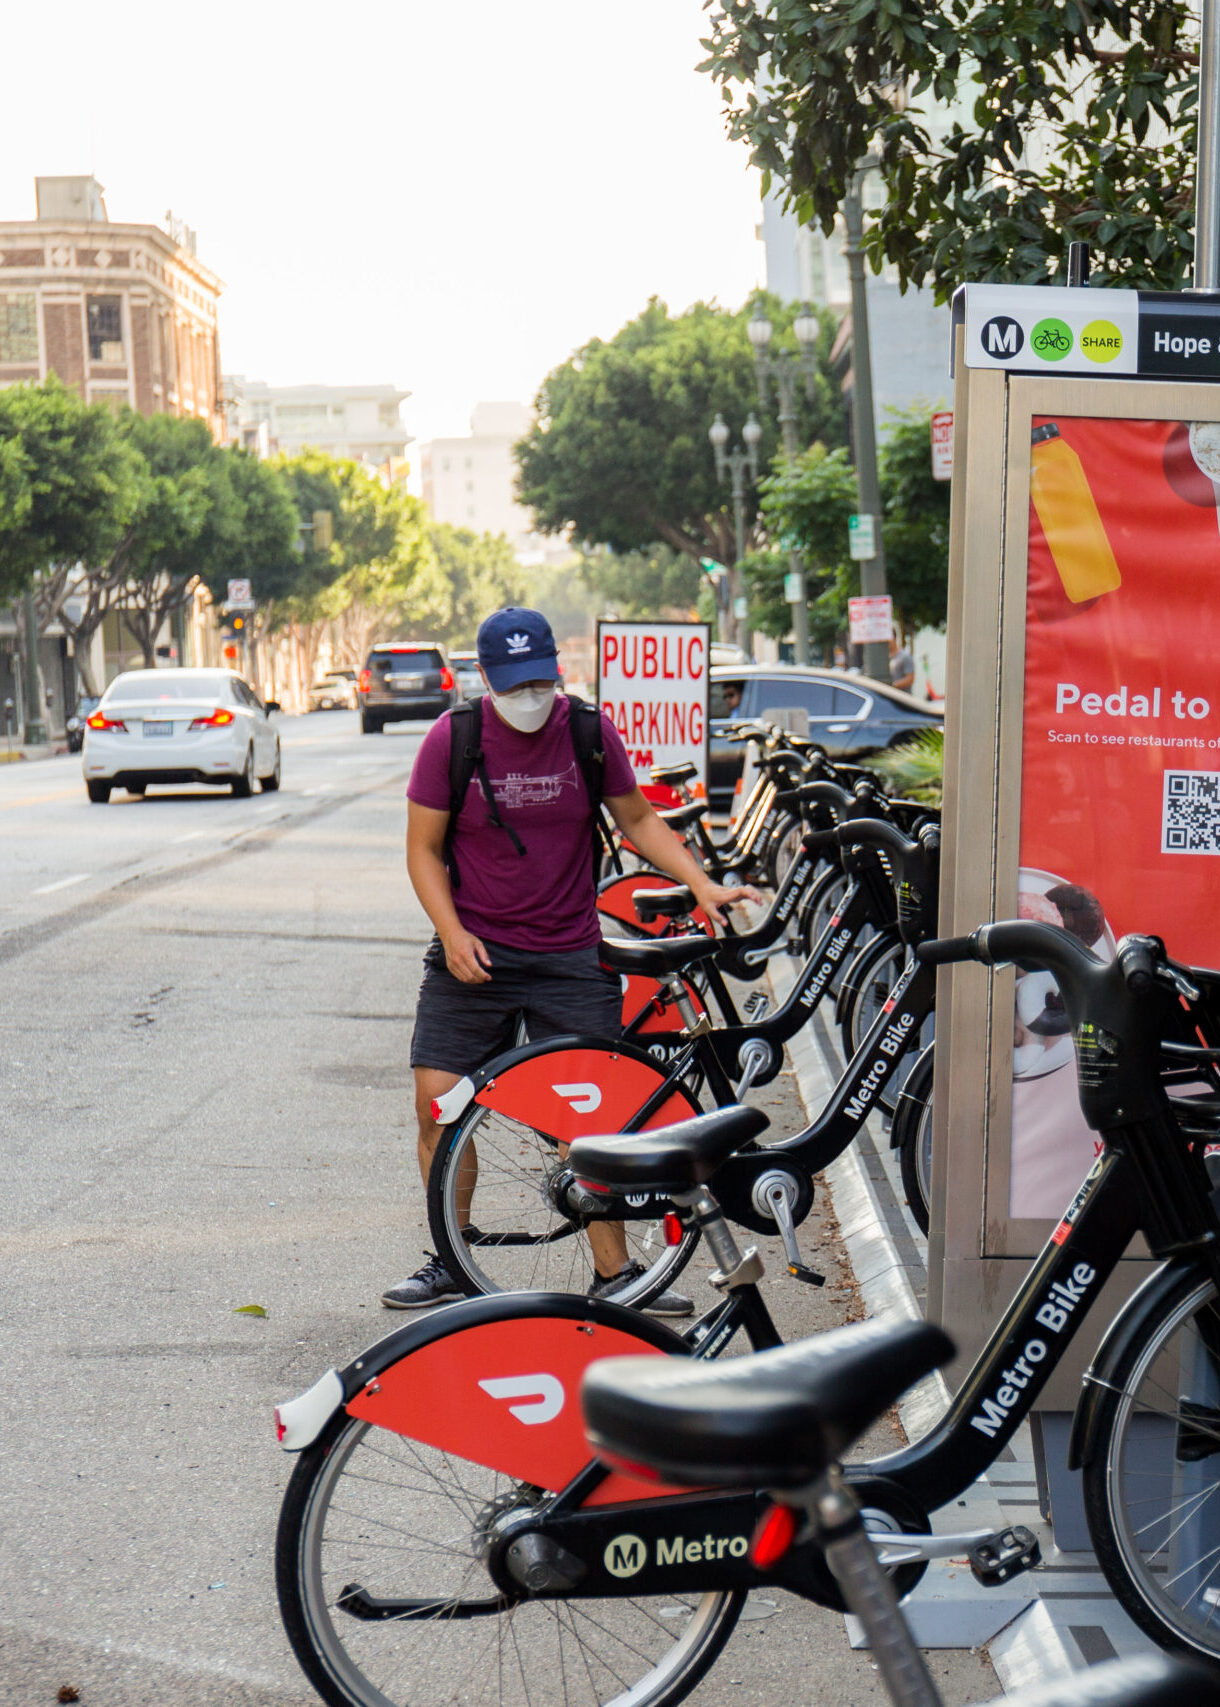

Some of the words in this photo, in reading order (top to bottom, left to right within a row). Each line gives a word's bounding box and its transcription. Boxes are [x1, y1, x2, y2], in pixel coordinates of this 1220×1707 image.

[1081, 335, 1121, 349] SHARE
[1153, 331, 1212, 358] Hope
[602, 634, 704, 680] PUBLIC
[1056, 682, 1161, 718] Pedal
[1171, 690, 1211, 720] to
[1047, 729, 1082, 743] Scan
[1084, 731, 1099, 745] to
[1101, 734, 1126, 746] see
[1127, 734, 1206, 749] restaurants
[775, 884, 799, 923] Metro
[791, 859, 812, 889] Bike
[799, 961, 834, 1008] Metro
[823, 927, 852, 967] Bike
[843, 1057, 888, 1121] Metro
[878, 1011, 915, 1053] Bike
[970, 1338, 1047, 1438] Metro
[1035, 1261, 1096, 1333] Bike
[655, 1533, 749, 1567] Metro
